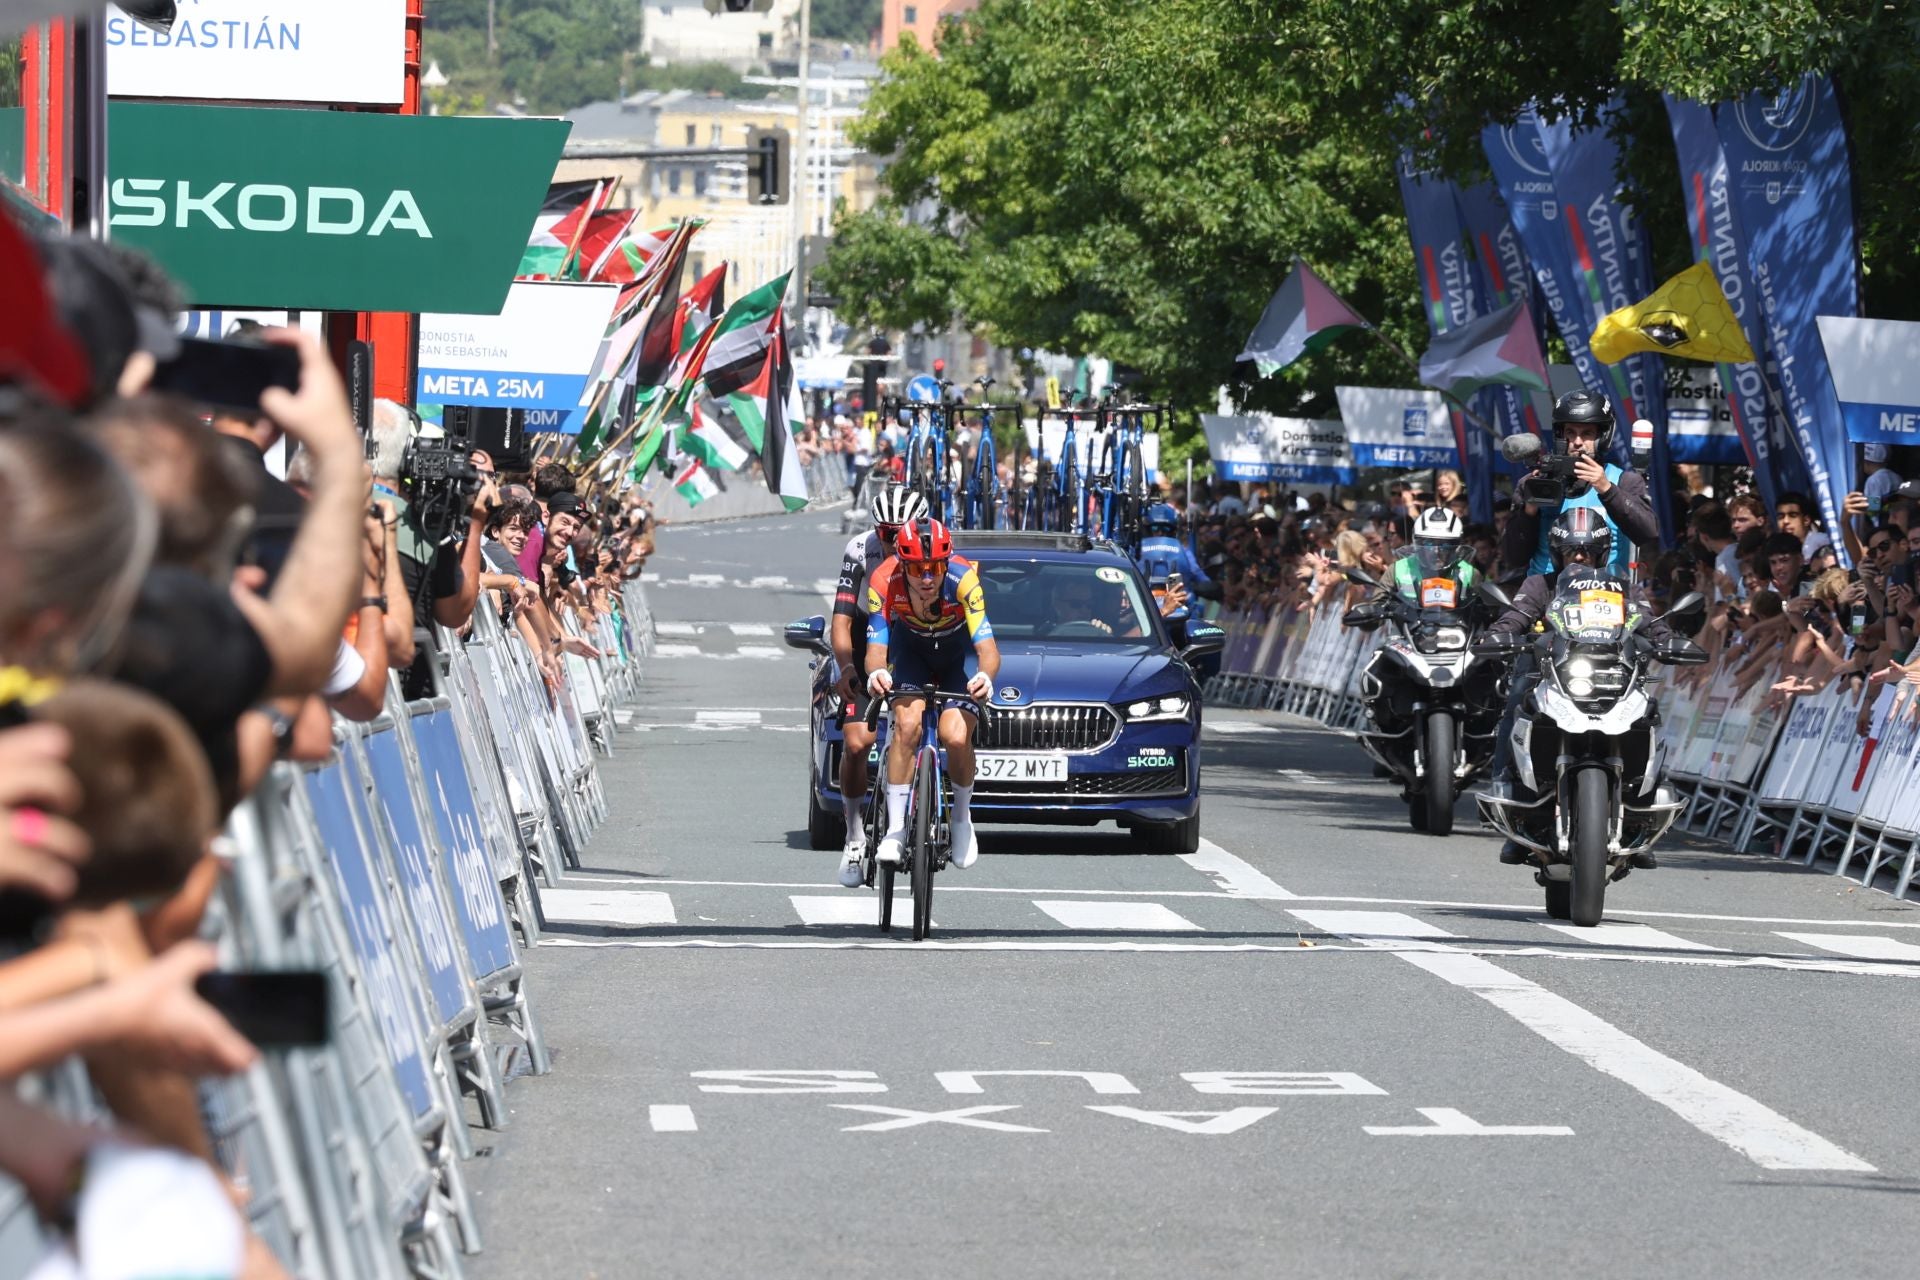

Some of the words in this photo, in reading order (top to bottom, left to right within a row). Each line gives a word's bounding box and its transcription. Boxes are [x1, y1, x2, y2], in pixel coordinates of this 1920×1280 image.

[419, 331, 475, 343] DONOSTIA
[419, 345, 441, 355] SAN
[445, 346, 508, 358] SEBASTIÁN
[423, 375, 489, 397] META
[496, 379, 544, 399] 25M
[1879, 412, 1920, 433] ME
[1283, 430, 1343, 444] Donostia
[1374, 448, 1415, 463] META
[1420, 452, 1450, 464] 75M
[1233, 464, 1268, 477] META
[1568, 579, 1606, 591] MOTOS
[1608, 582, 1623, 591] TV
[1434, 590, 1442, 599] 6
[1594, 603, 1611, 615] 99
[1565, 609, 1582, 626] H
[1578, 629, 1601, 638] MOTOS
[1139, 748, 1166, 756] HYBRID
[1026, 760, 1062, 778] MYT
